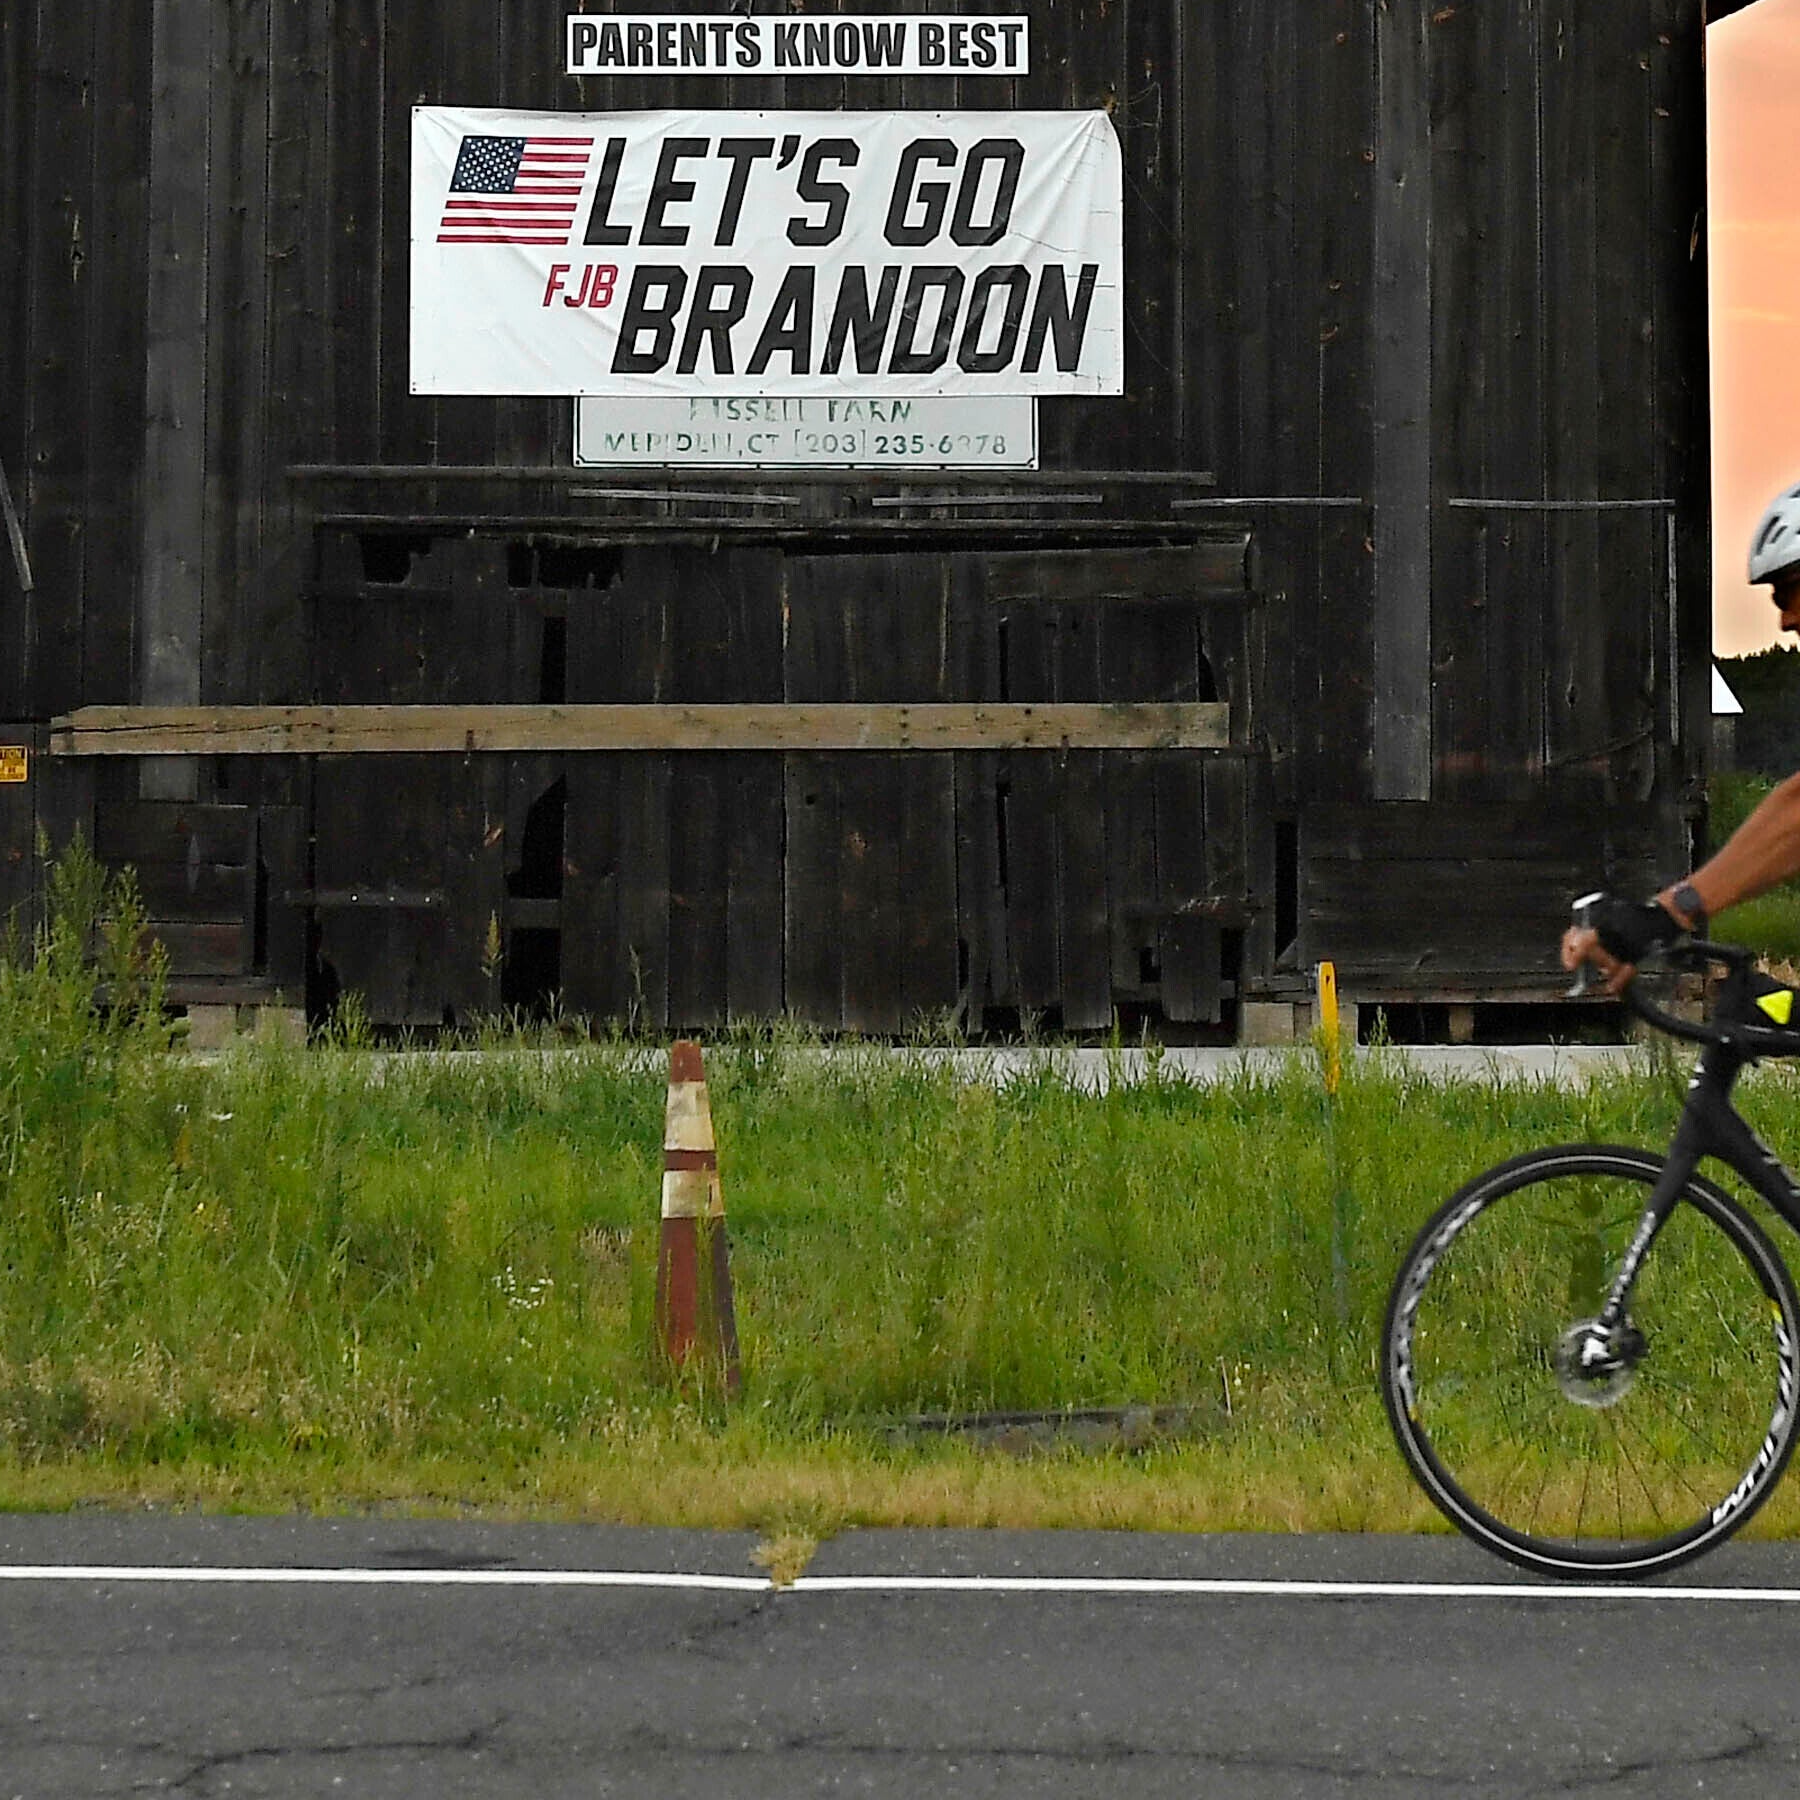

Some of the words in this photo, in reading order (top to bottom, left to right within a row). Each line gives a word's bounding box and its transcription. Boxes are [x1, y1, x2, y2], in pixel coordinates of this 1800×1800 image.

[572, 22, 762, 68] PARENTS
[774, 22, 907, 68] KNOW
[918, 22, 1024, 69] BEST
[580, 136, 861, 247] LET'S
[883, 138, 1026, 248] GO
[543, 264, 619, 308] FJB
[609, 263, 1100, 376] BRANDON
